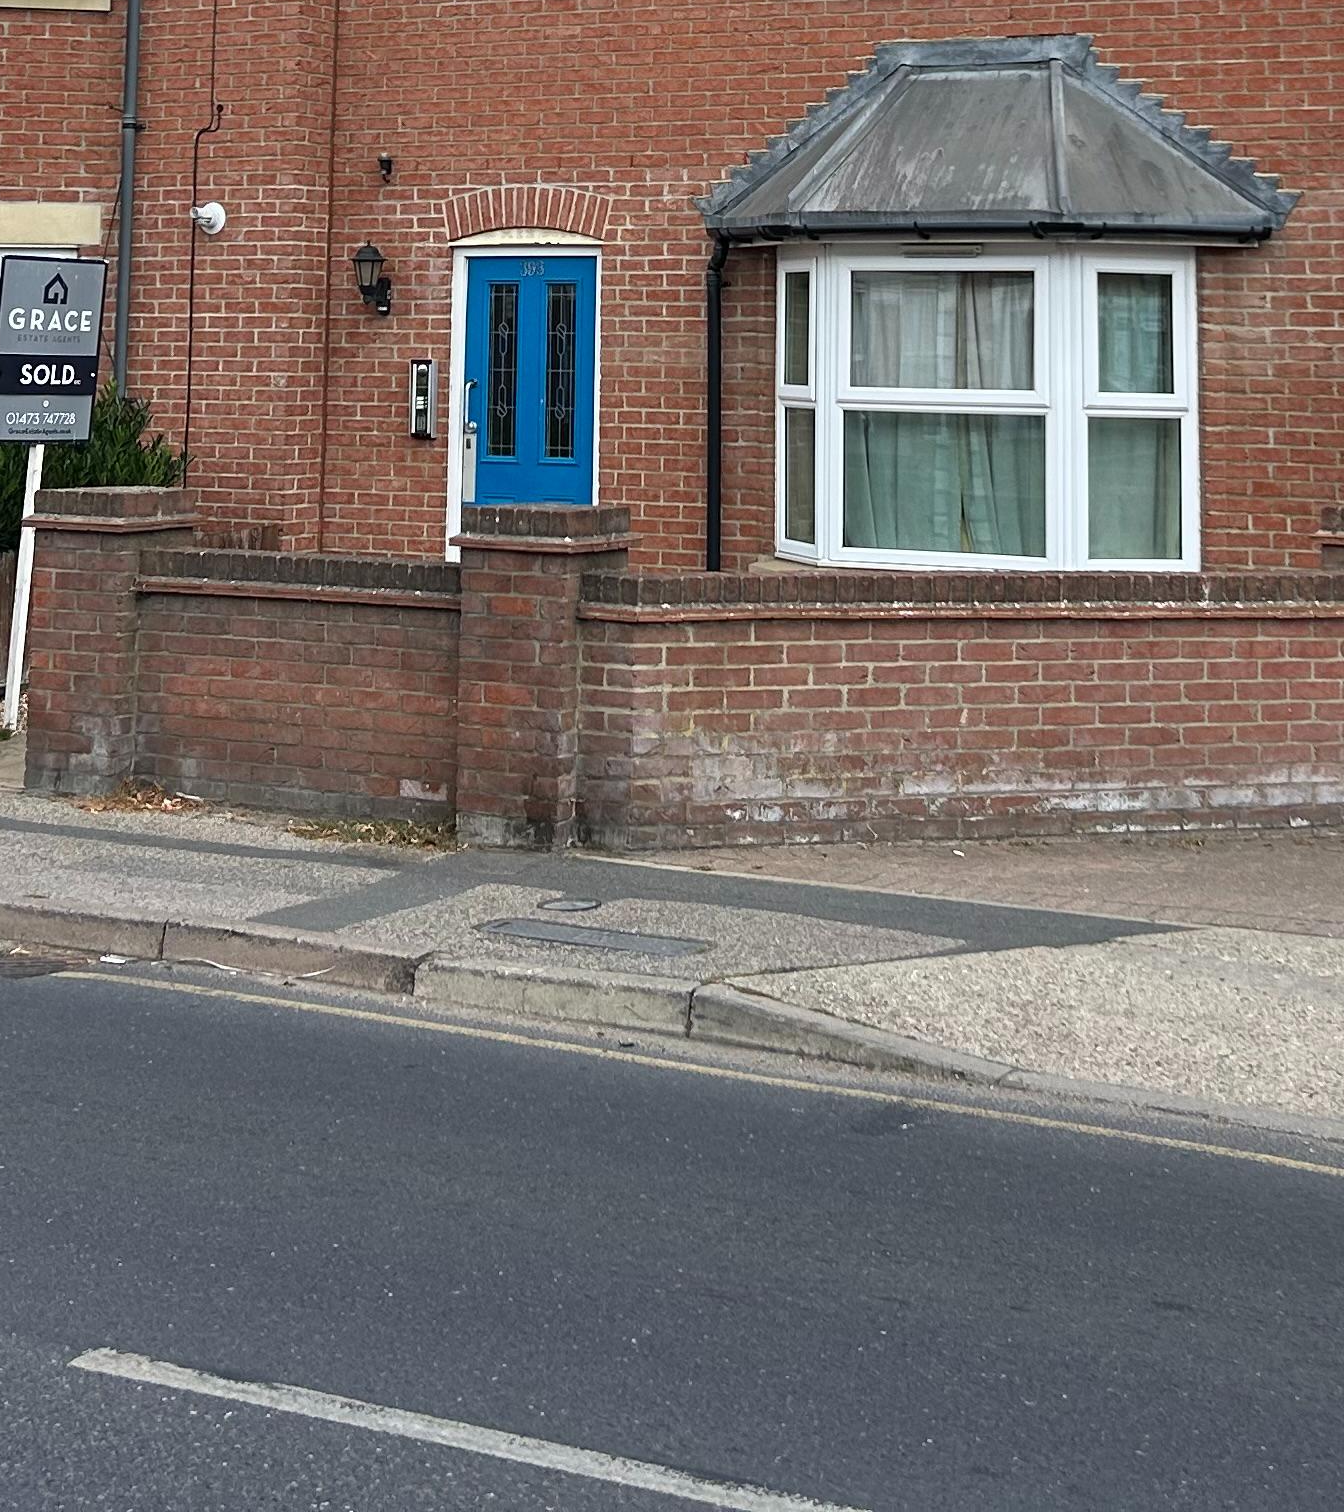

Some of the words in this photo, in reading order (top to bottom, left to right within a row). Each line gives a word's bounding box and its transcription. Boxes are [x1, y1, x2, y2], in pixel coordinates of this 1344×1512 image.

[8, 307, 93, 332] GRACE
[17, 333, 49, 343] ESTATE
[51, 334, 81, 344] AGENTS
[19, 363, 75, 385] SOLD
[6, 411, 40, 425] 01473
[42, 412, 76, 425] 747728
